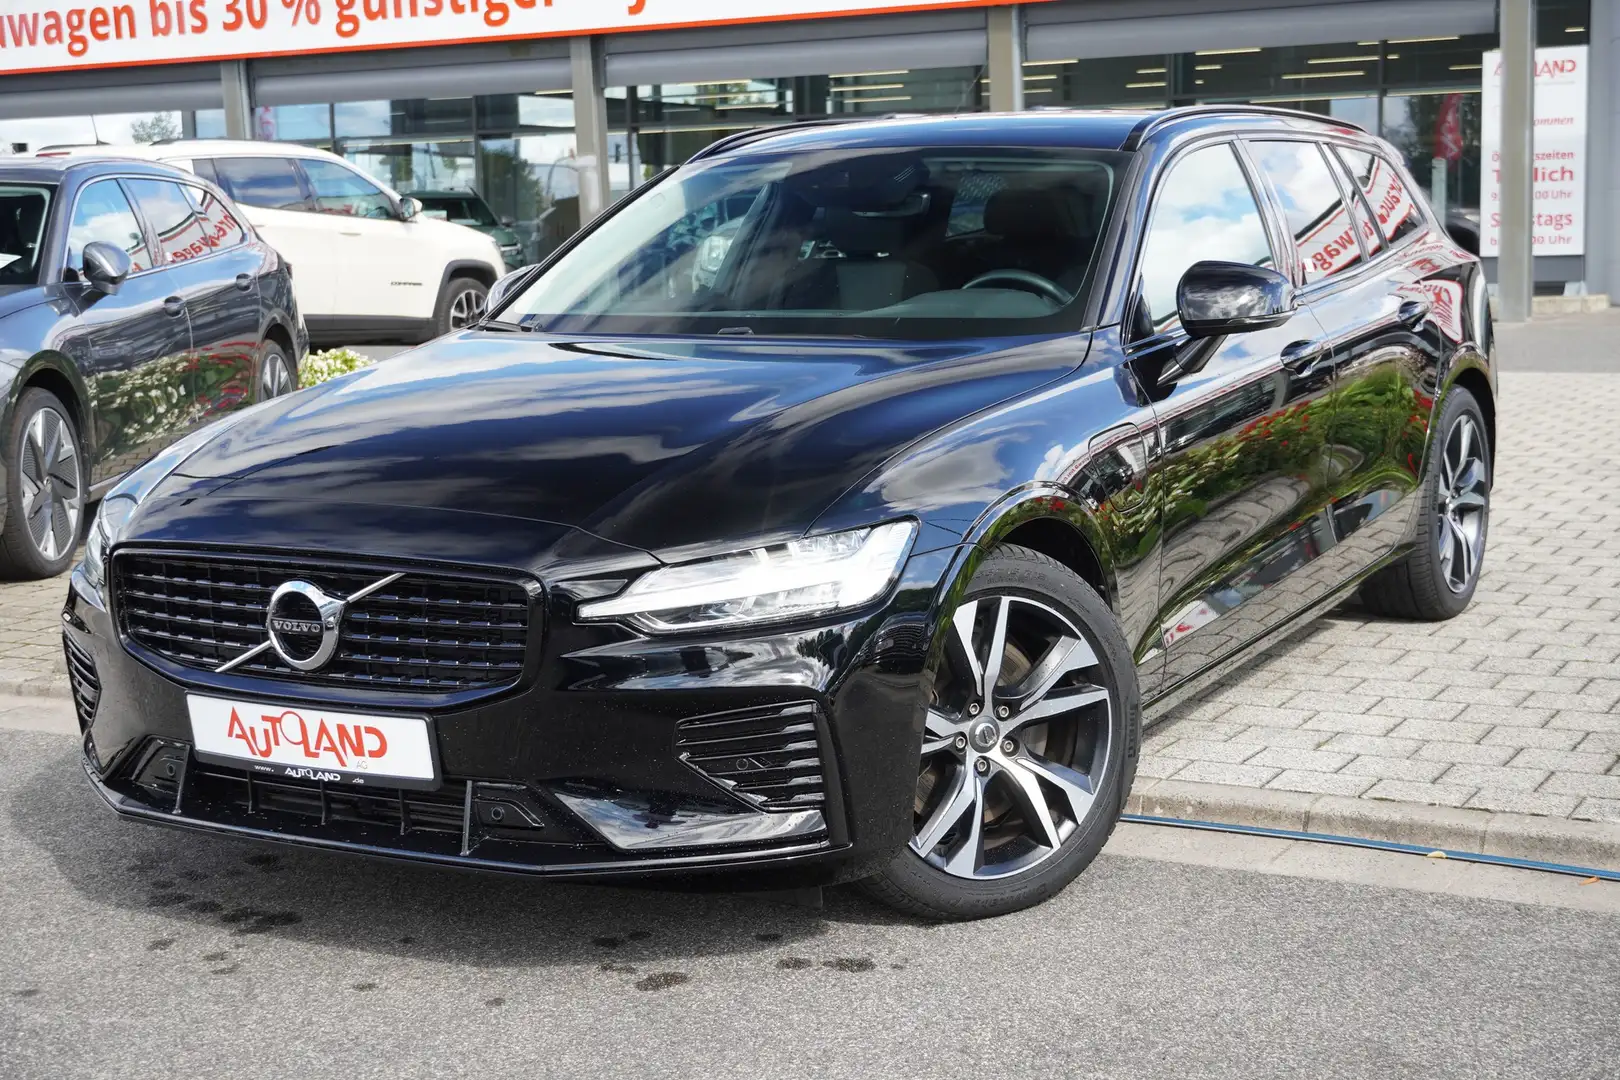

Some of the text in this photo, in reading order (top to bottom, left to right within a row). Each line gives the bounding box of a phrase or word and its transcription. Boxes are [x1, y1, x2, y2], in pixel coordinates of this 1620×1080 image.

[0, 3, 137, 57] wagen
[150, 0, 208, 36] bis
[222, 0, 268, 31] 30
[272, 620, 321, 633] VOLVO
[227, 706, 388, 768] AUTOLAND
[285, 767, 341, 782] AUTOLAND
